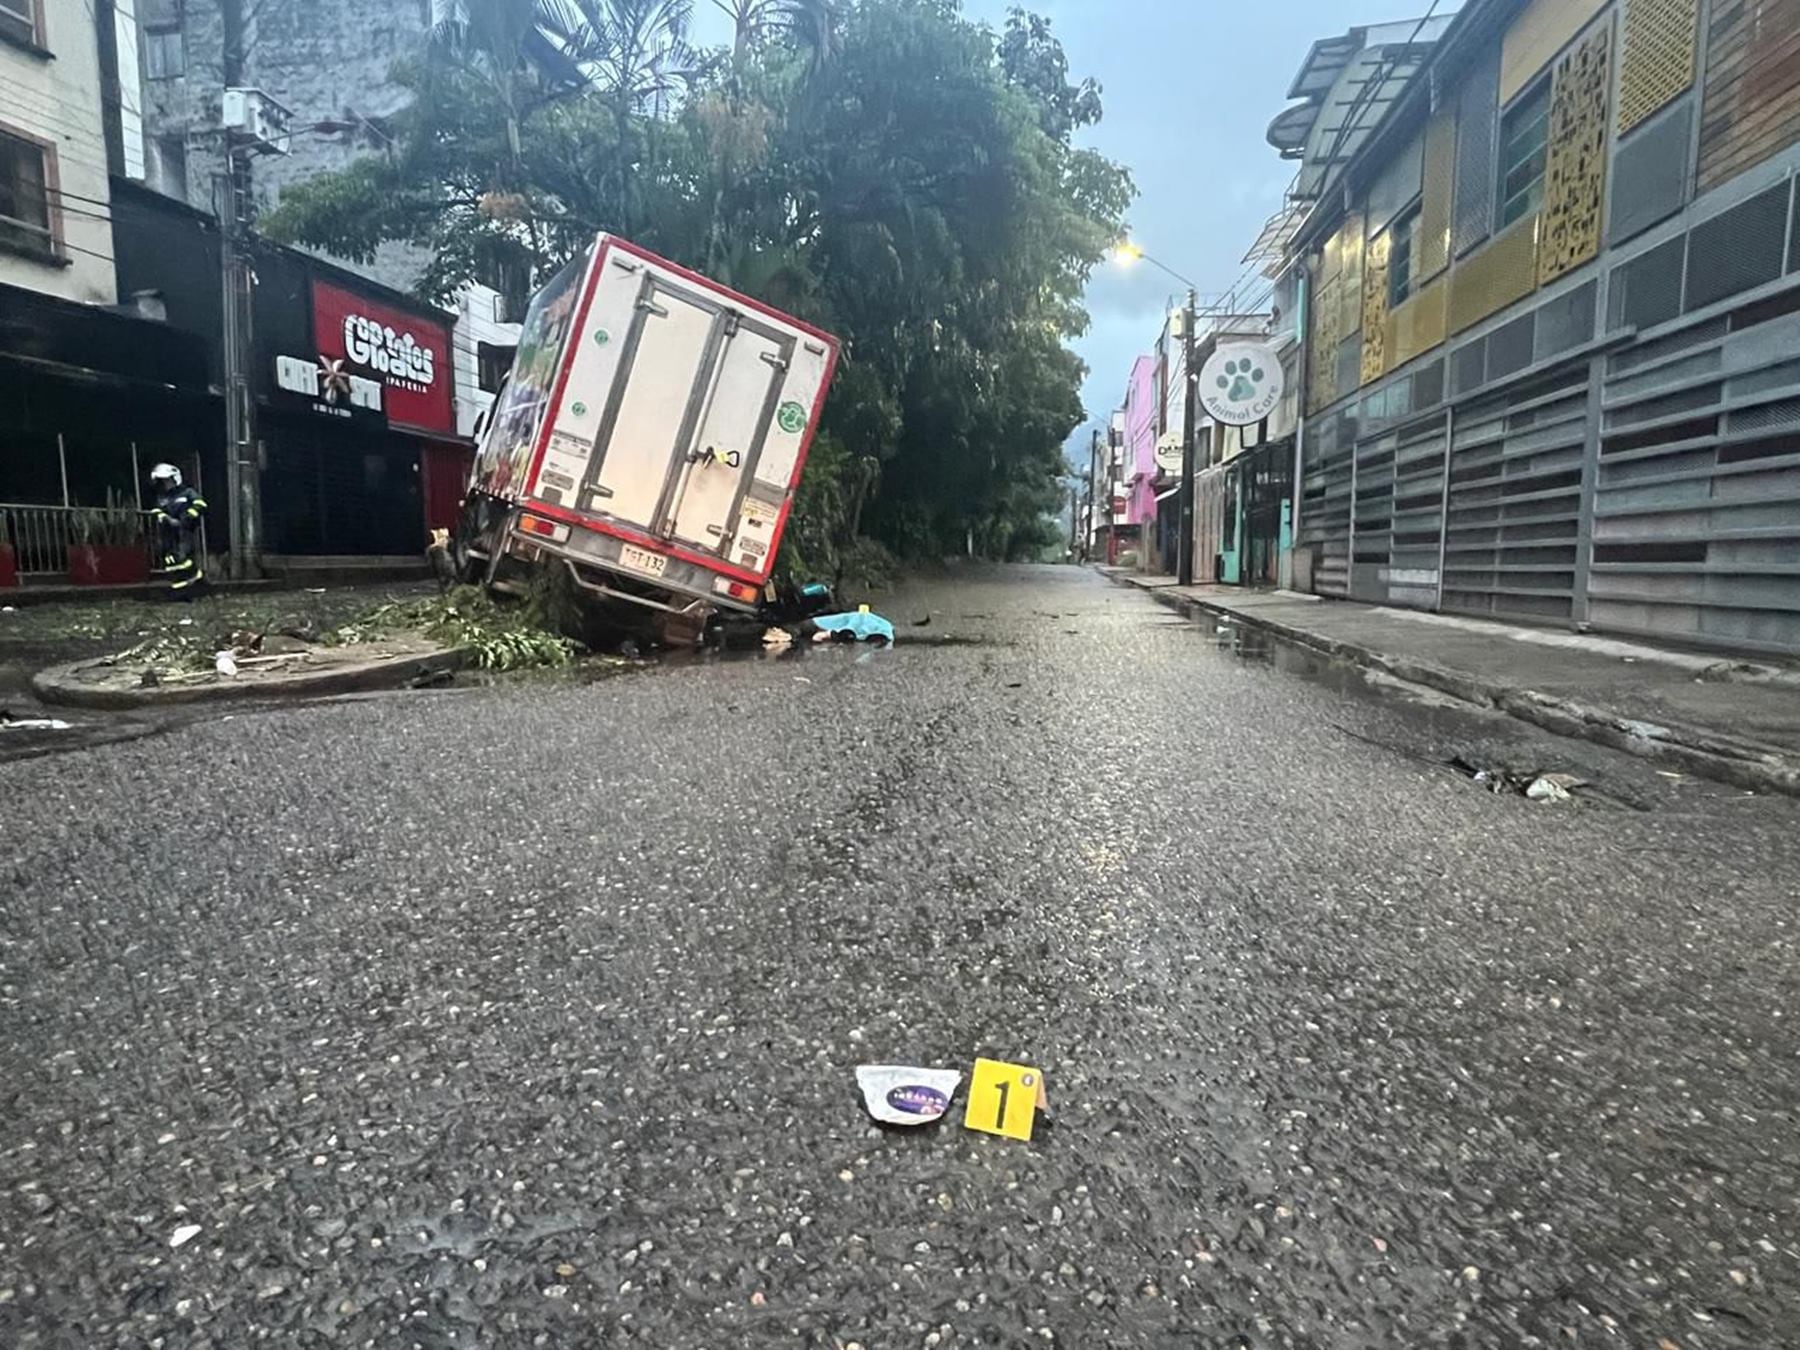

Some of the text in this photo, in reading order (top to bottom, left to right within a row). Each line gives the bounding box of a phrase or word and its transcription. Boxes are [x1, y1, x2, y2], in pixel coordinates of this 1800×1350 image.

[1206, 384, 1279, 420] Animal Care
[994, 1080, 1010, 1130] 1
